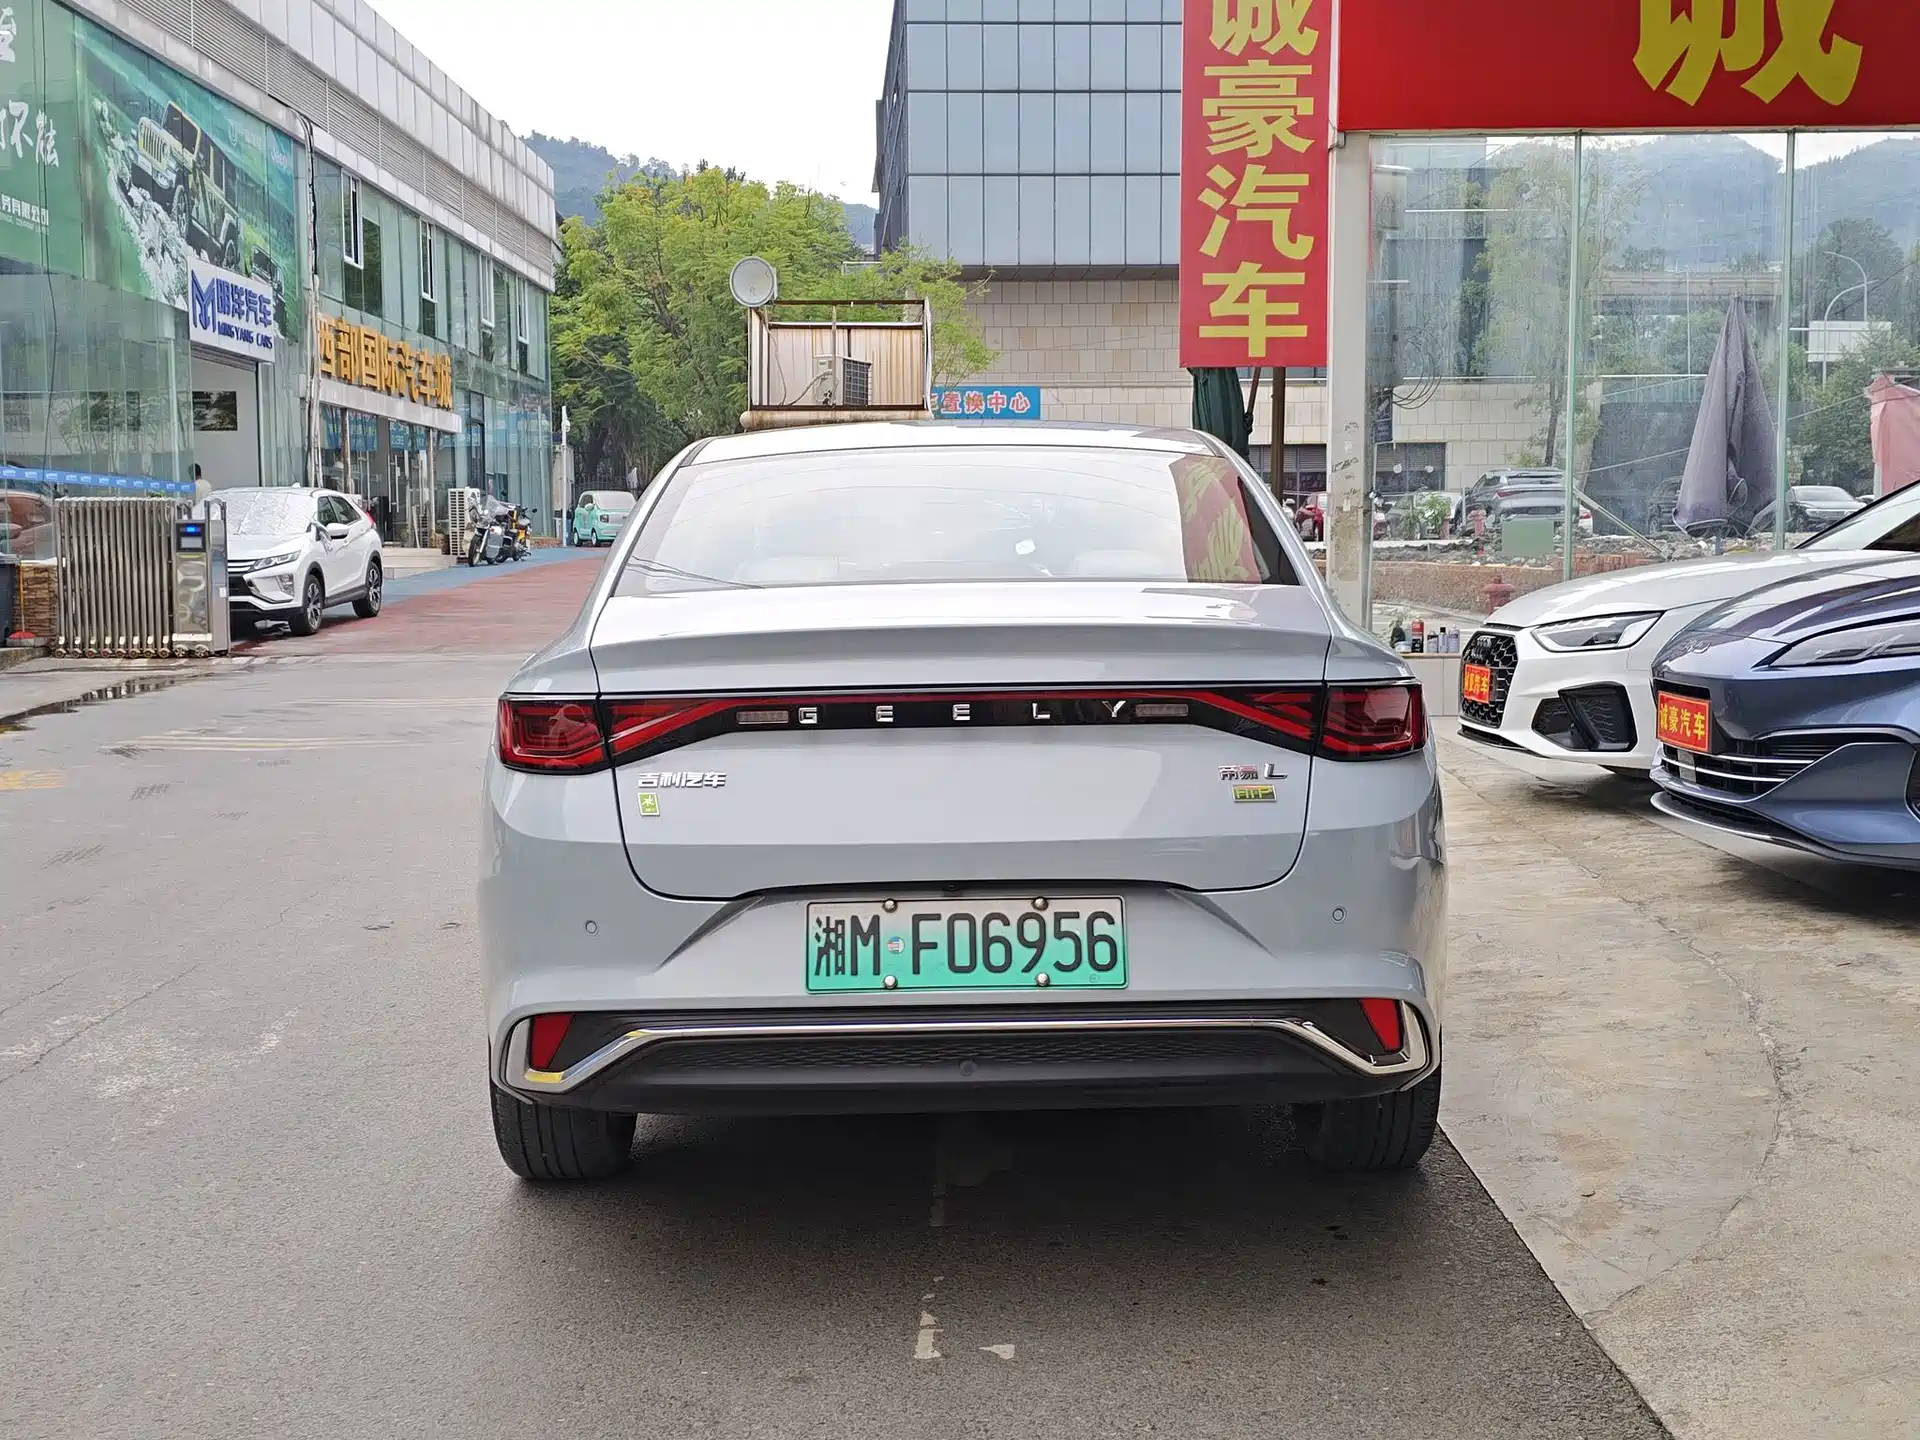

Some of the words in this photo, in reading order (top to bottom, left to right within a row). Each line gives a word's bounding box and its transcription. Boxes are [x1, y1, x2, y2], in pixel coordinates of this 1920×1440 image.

[318, 313, 452, 411] 西部国际汽车城
[799, 700, 1126, 725] GEELY
[1660, 703, 1705, 740] 诚豪汽车
[638, 771, 727, 789] 吉利汽车
[912, 910, 1118, 975] F06956
